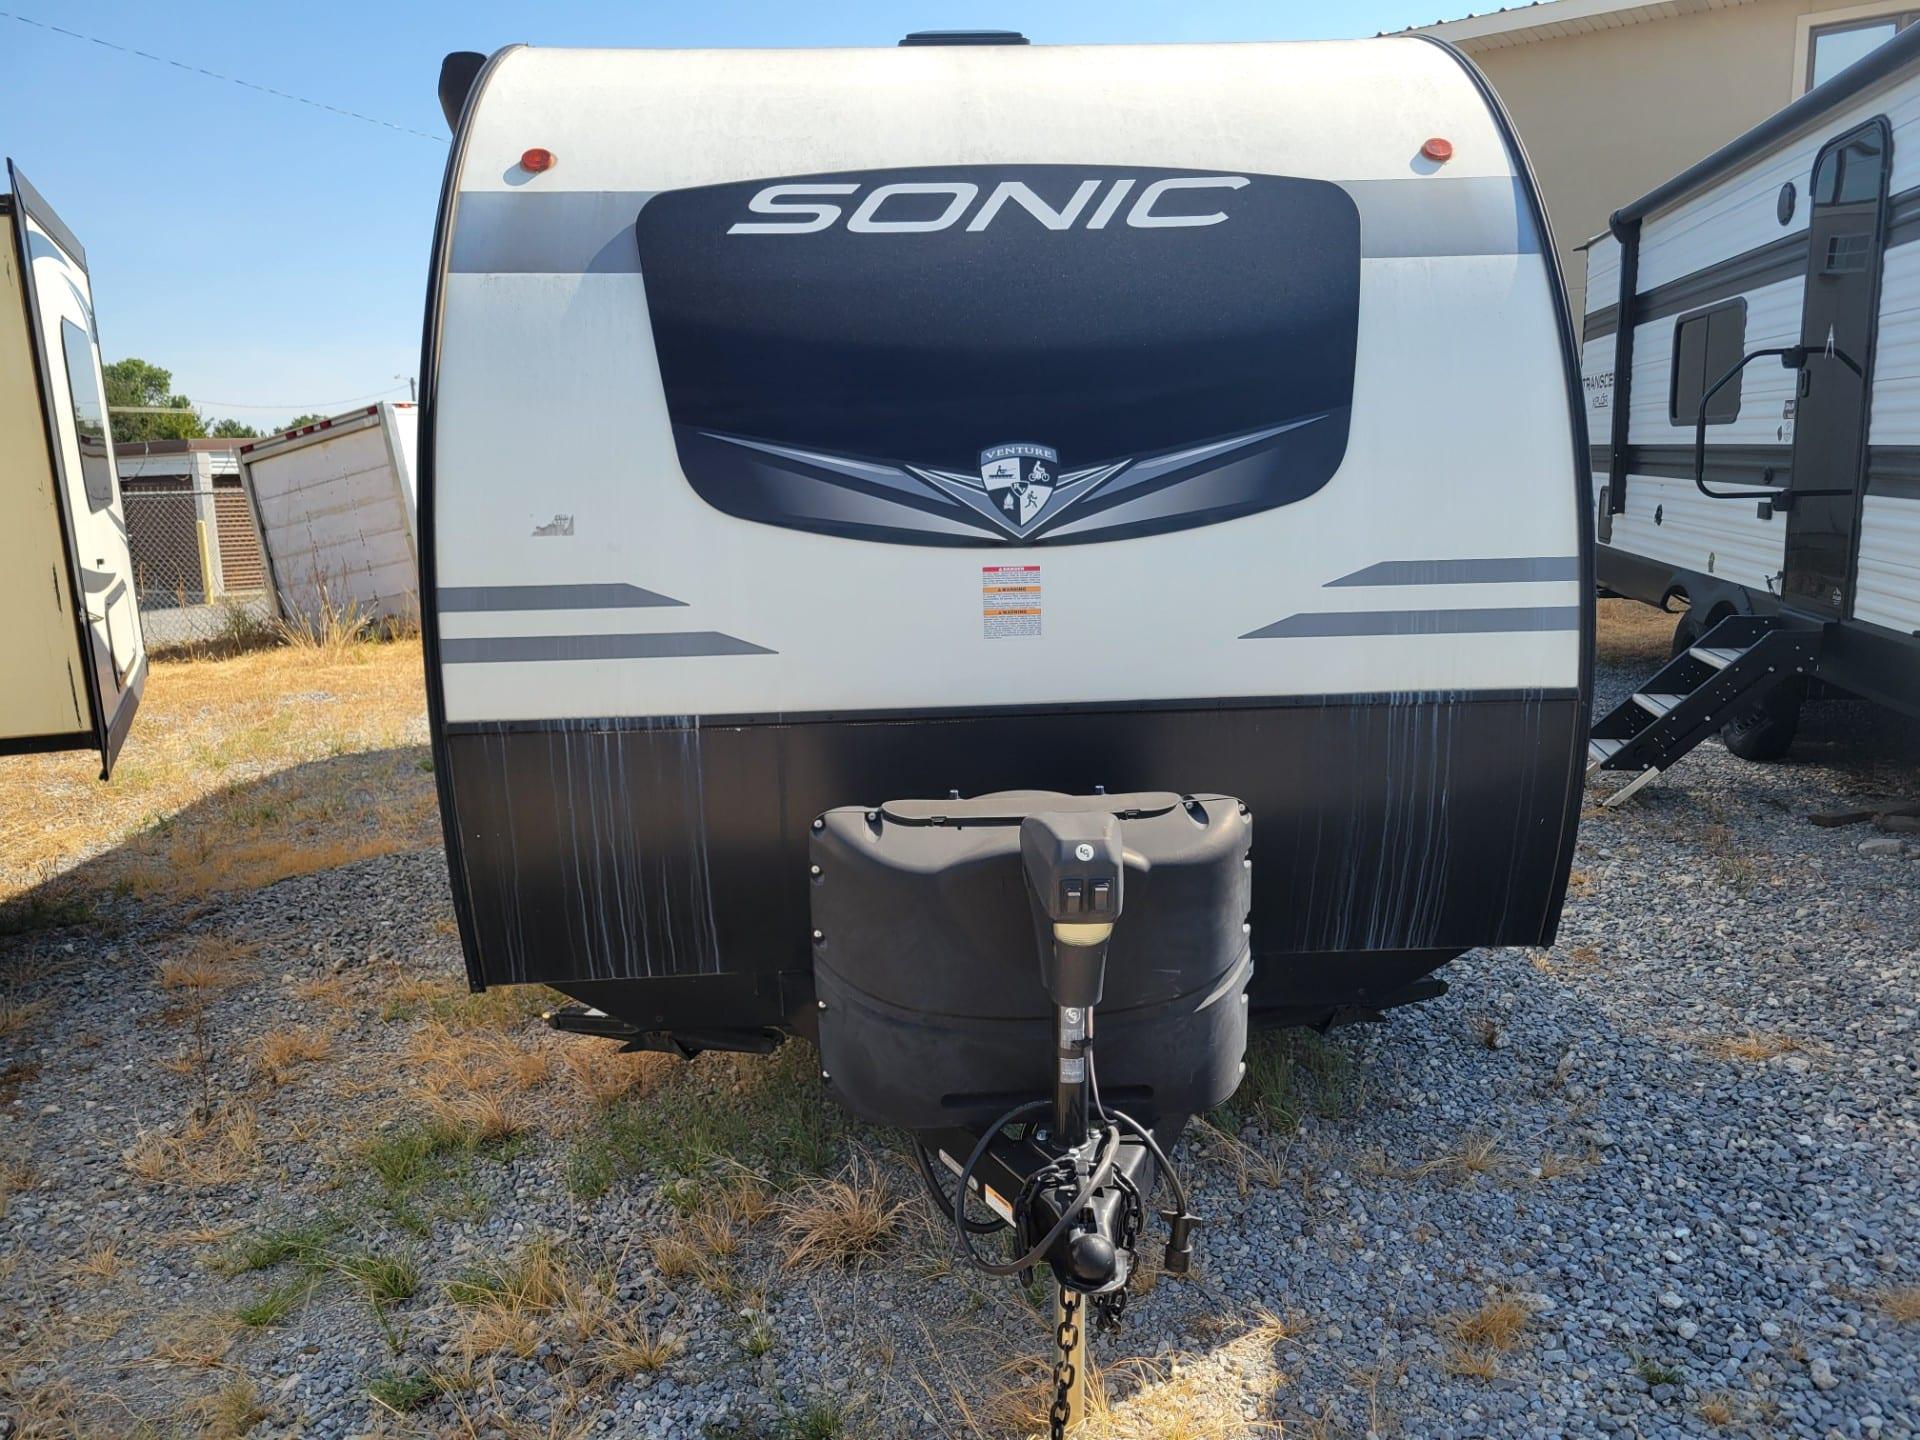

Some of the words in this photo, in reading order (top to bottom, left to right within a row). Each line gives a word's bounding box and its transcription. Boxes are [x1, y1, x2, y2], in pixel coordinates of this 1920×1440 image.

[726, 176, 1251, 235] SONIC
[1582, 372, 1615, 391] TRANSCE
[985, 446, 1053, 459] VENTURE
[1014, 482, 1026, 494] RV
